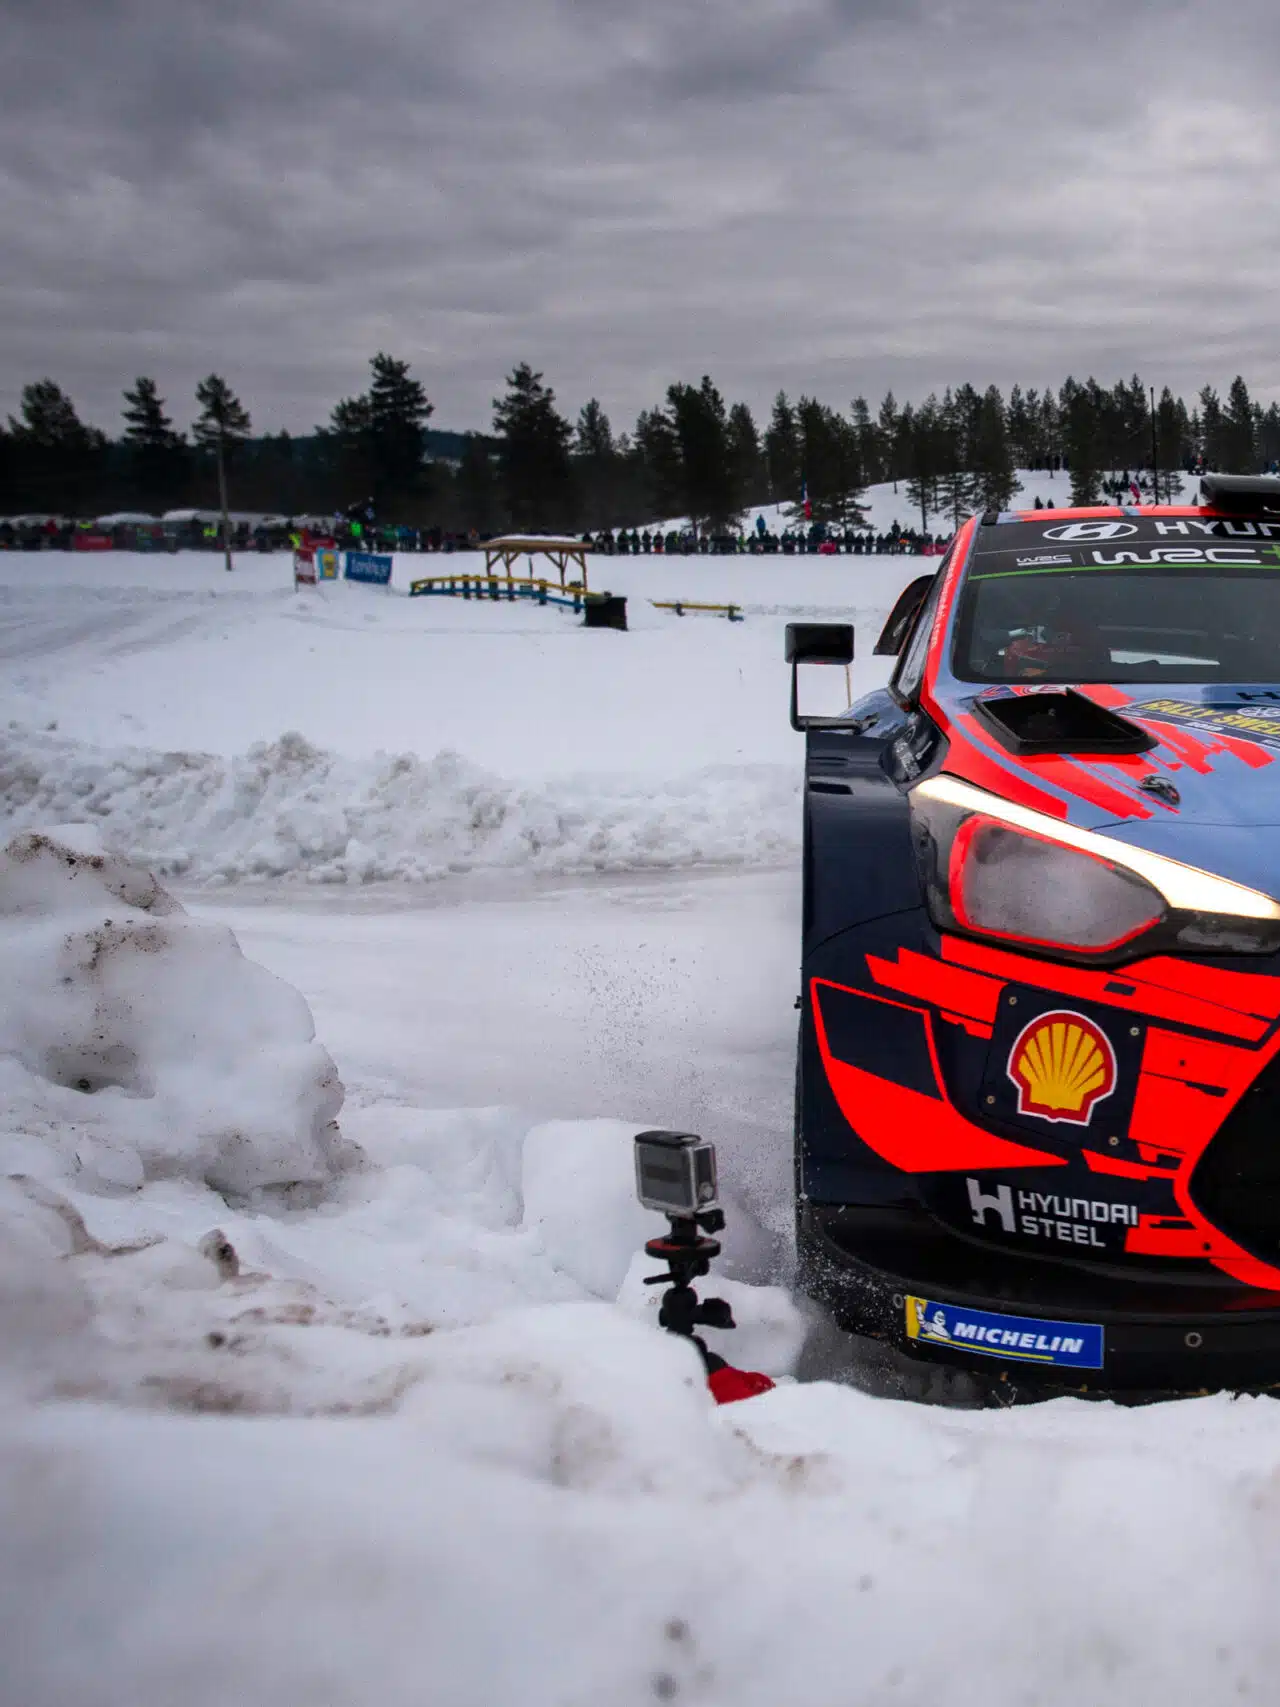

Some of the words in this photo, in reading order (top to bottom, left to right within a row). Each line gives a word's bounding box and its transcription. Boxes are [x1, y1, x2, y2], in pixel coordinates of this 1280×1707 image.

[1016, 554, 1072, 566] WRC
[1139, 700, 1223, 718] RALLY
[1018, 1190, 1140, 1226] HYUNDAI
[1021, 1215, 1106, 1247] STEEL
[953, 1322, 1084, 1354] MICHELIN
